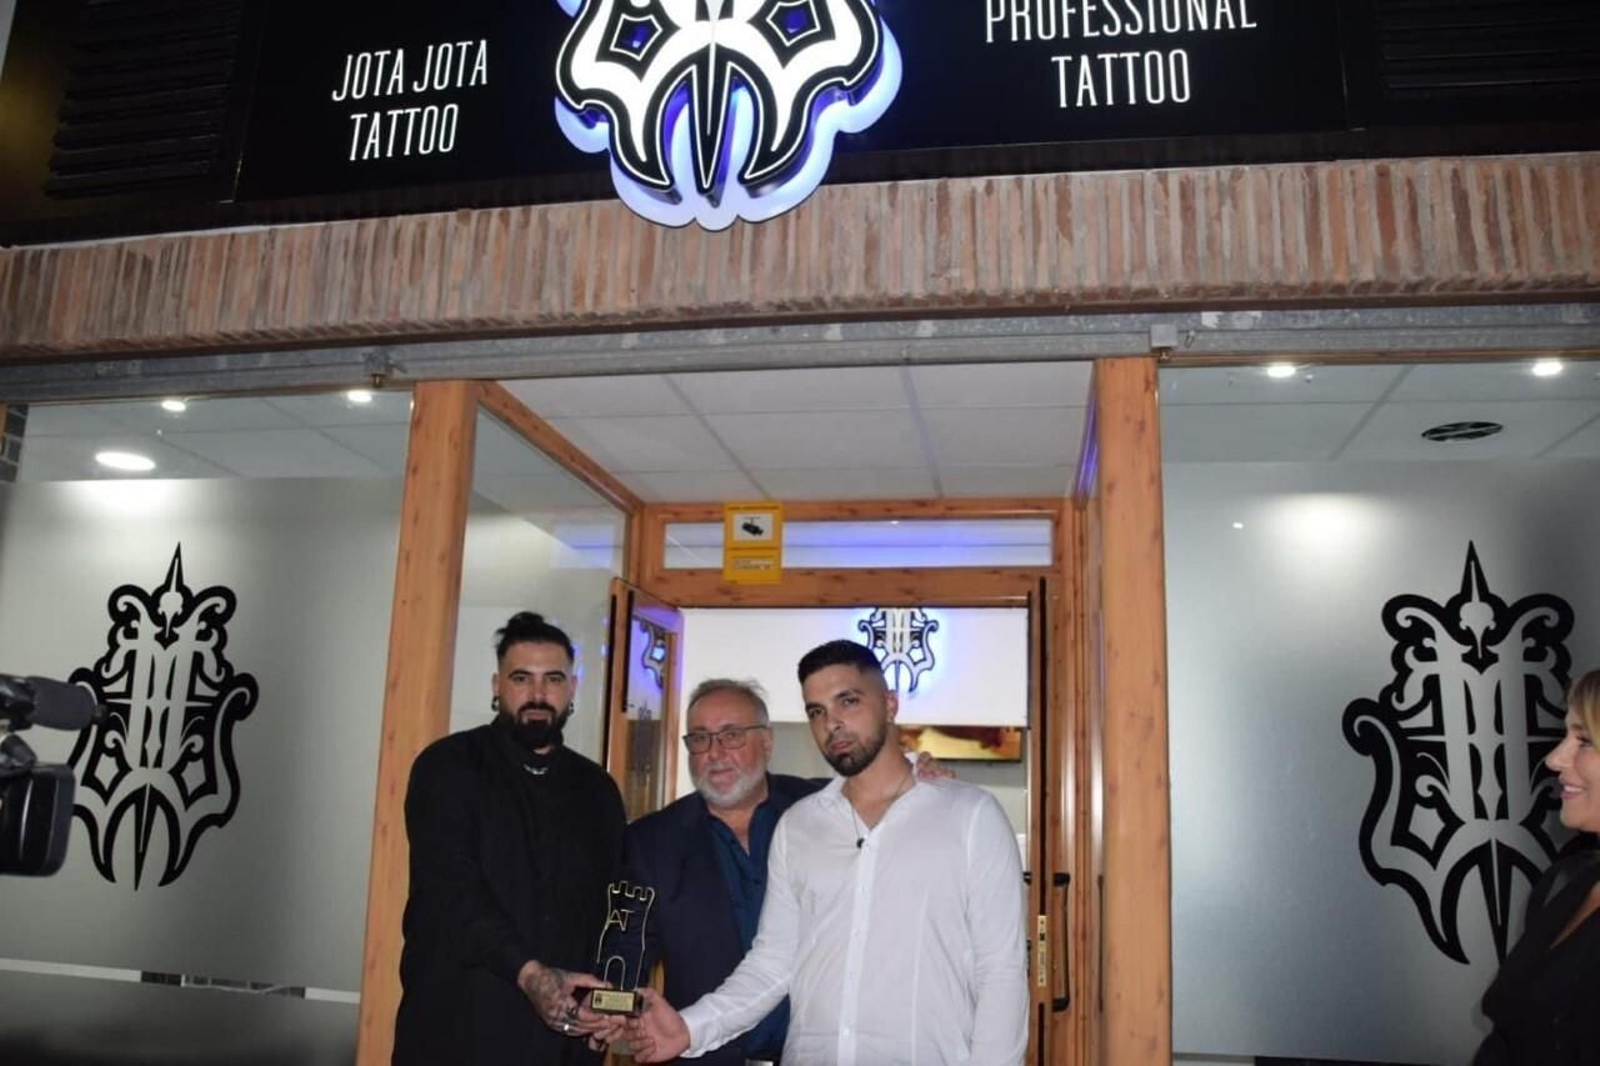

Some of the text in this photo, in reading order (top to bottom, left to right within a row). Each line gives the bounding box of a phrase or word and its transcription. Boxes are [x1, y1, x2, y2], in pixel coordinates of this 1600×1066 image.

[985, 0, 1258, 43] PROFESSIONAL
[331, 39, 488, 102] JOTA JOTA
[1050, 48, 1191, 108] TATTOO
[349, 103, 459, 161] TATTOO
